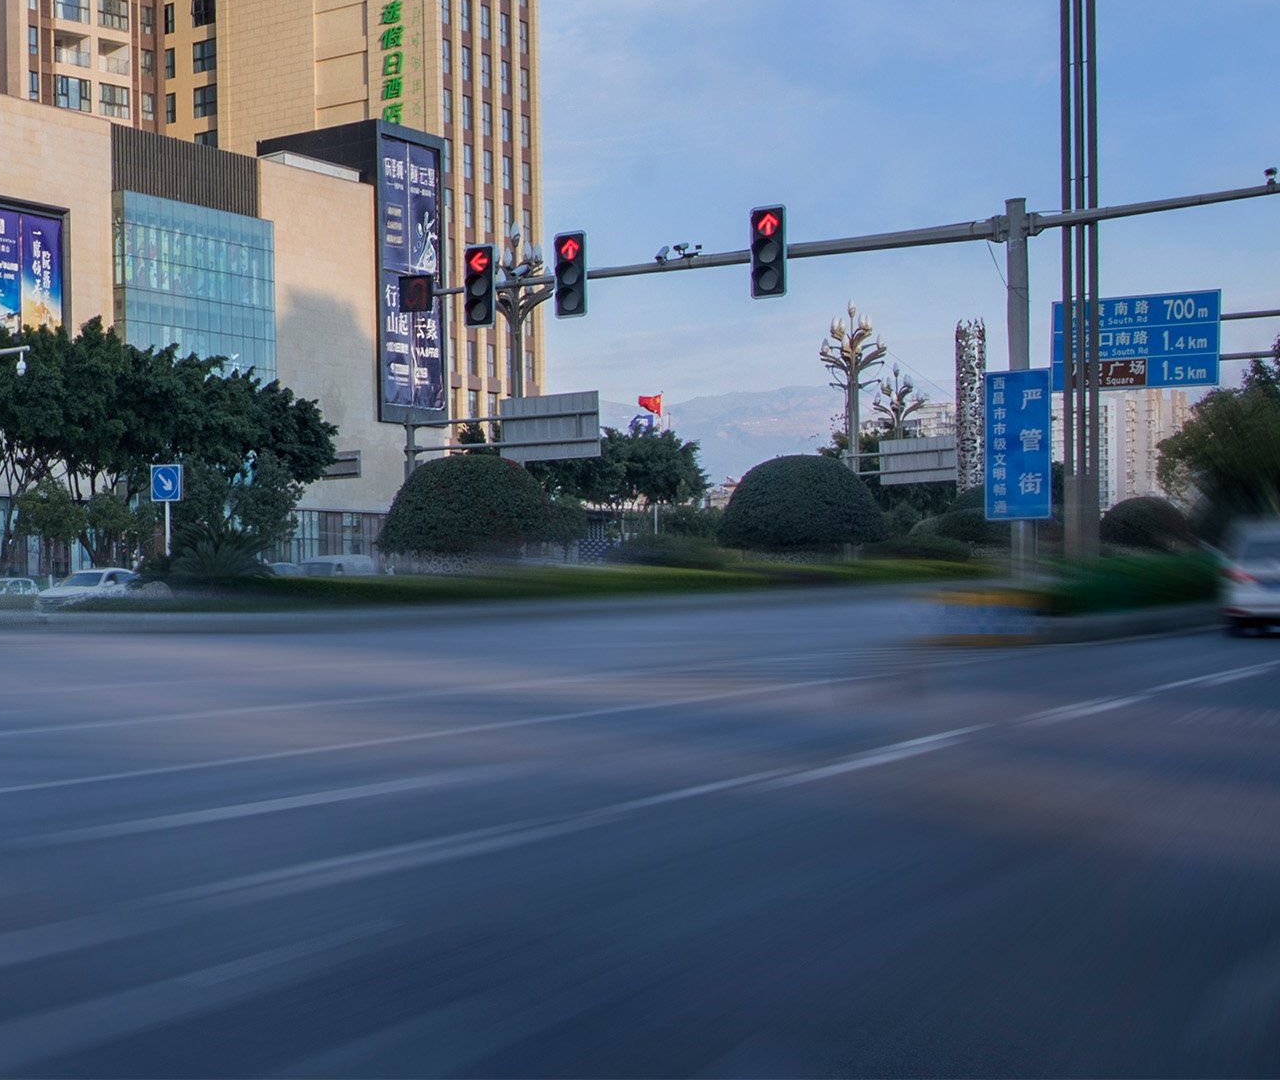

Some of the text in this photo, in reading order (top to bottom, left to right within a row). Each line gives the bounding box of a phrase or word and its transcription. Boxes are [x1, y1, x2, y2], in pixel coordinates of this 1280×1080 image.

[1163, 298, 1209, 320] 700 m
[1108, 317, 1134, 325] South
[1137, 315, 1148, 323] Rd
[1162, 330, 1208, 351] 1.4 km
[1111, 348, 1135, 357] South
[1138, 347, 1149, 355] Rd
[1162, 360, 1207, 381] 1.5 km
[1106, 376, 1135, 387] Square
[992, 376, 1008, 514] 西昌市市级文明畅通
[1019, 388, 1043, 496] 严管街
